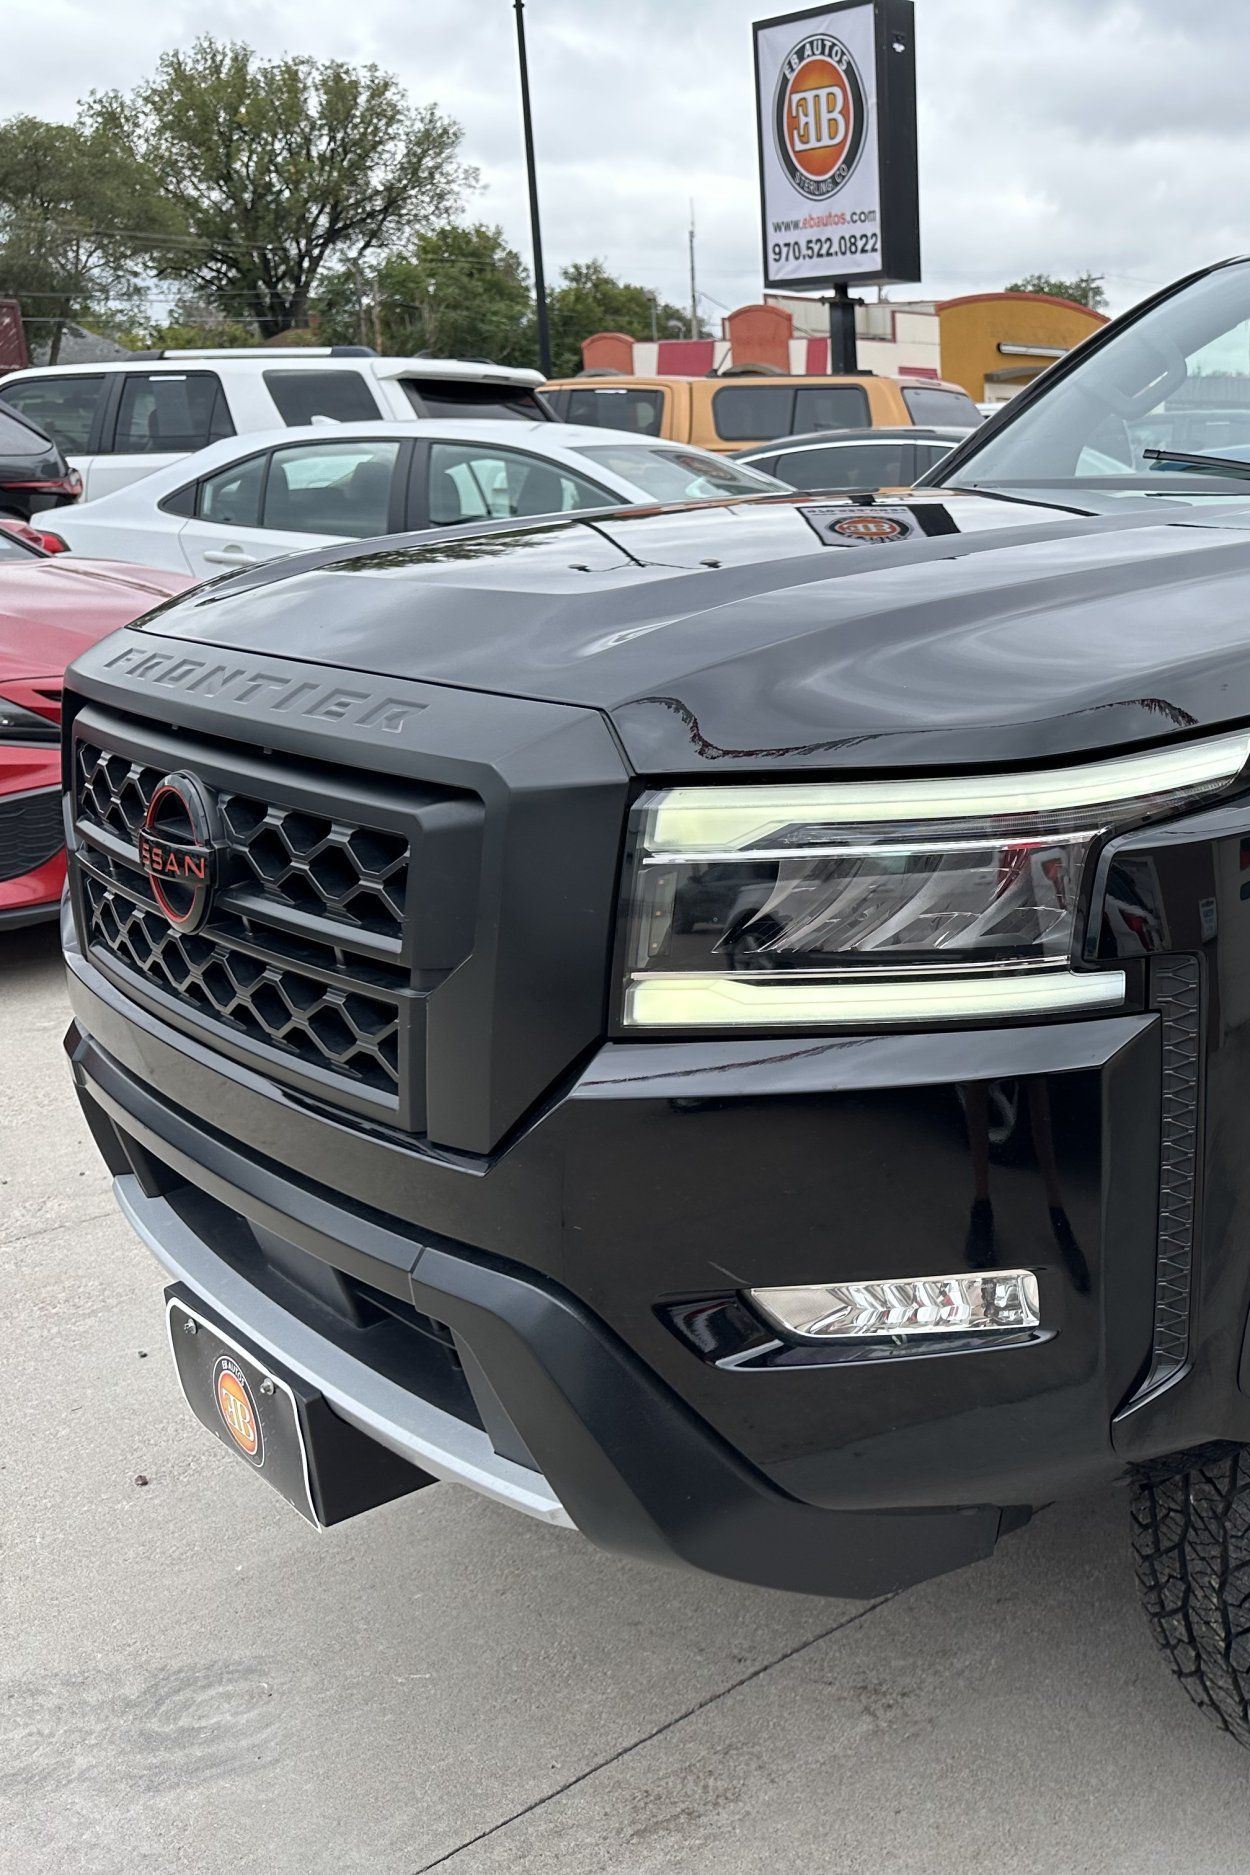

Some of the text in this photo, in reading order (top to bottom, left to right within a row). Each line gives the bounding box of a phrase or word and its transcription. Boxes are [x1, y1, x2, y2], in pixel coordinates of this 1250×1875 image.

[783, 39, 850, 80] EB AUTOS
[794, 163, 849, 195] STERLING CO
[772, 210, 877, 233] www.ebautos.com
[772, 232, 879, 263] 970.522.0822
[103, 647, 431, 734] FRONTIER
[142, 842, 205, 879] SSAN
